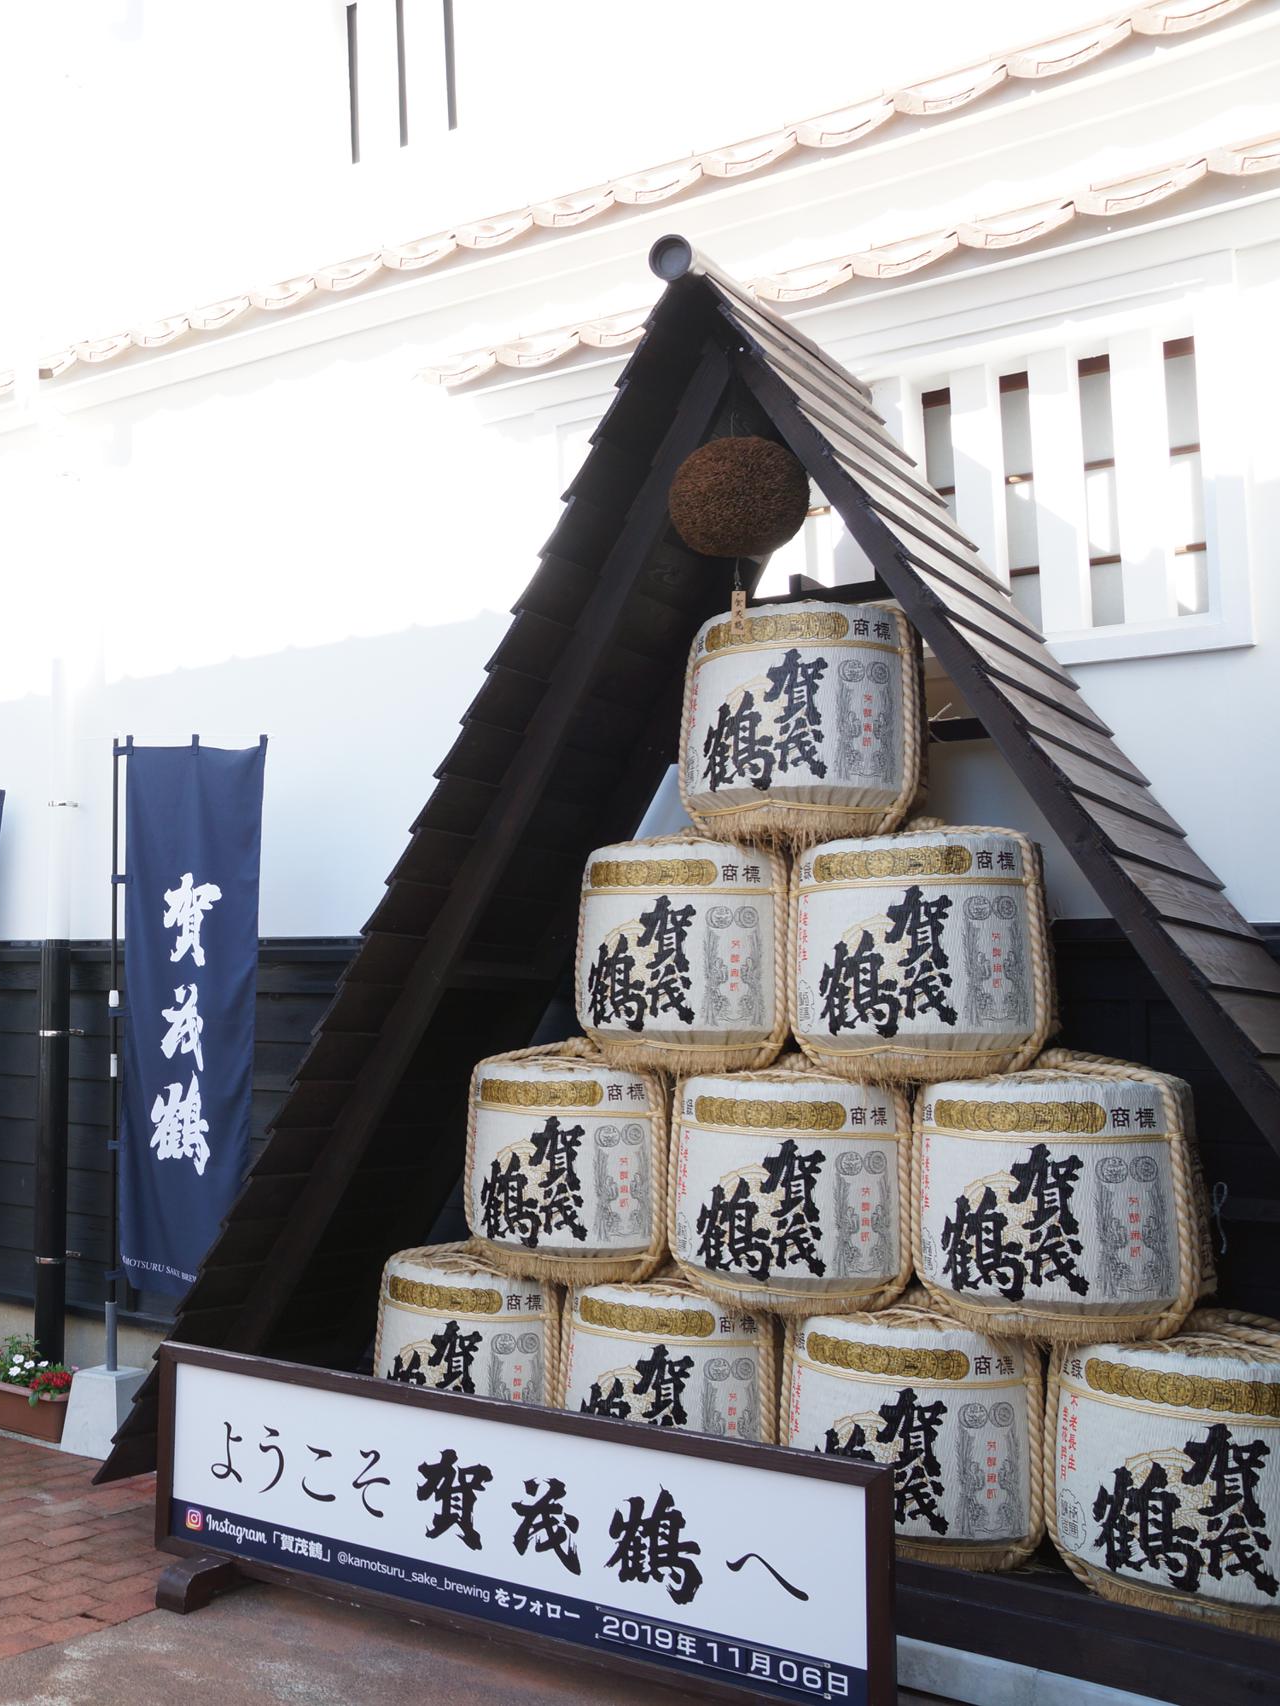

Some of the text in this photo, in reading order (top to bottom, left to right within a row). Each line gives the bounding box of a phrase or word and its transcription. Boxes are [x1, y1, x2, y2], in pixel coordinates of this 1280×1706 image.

[976, 850, 1016, 871] 商標
[150, 872, 222, 1176] 賀茂鶴
[607, 1082, 645, 1101] 商標
[1110, 1107, 1157, 1129] 商標
[506, 1294, 543, 1311] 商標
[206, 1513, 580, 1619] Instagram 「賀茂鶴」 @kamotsuru_sake_brewing をフォロー
